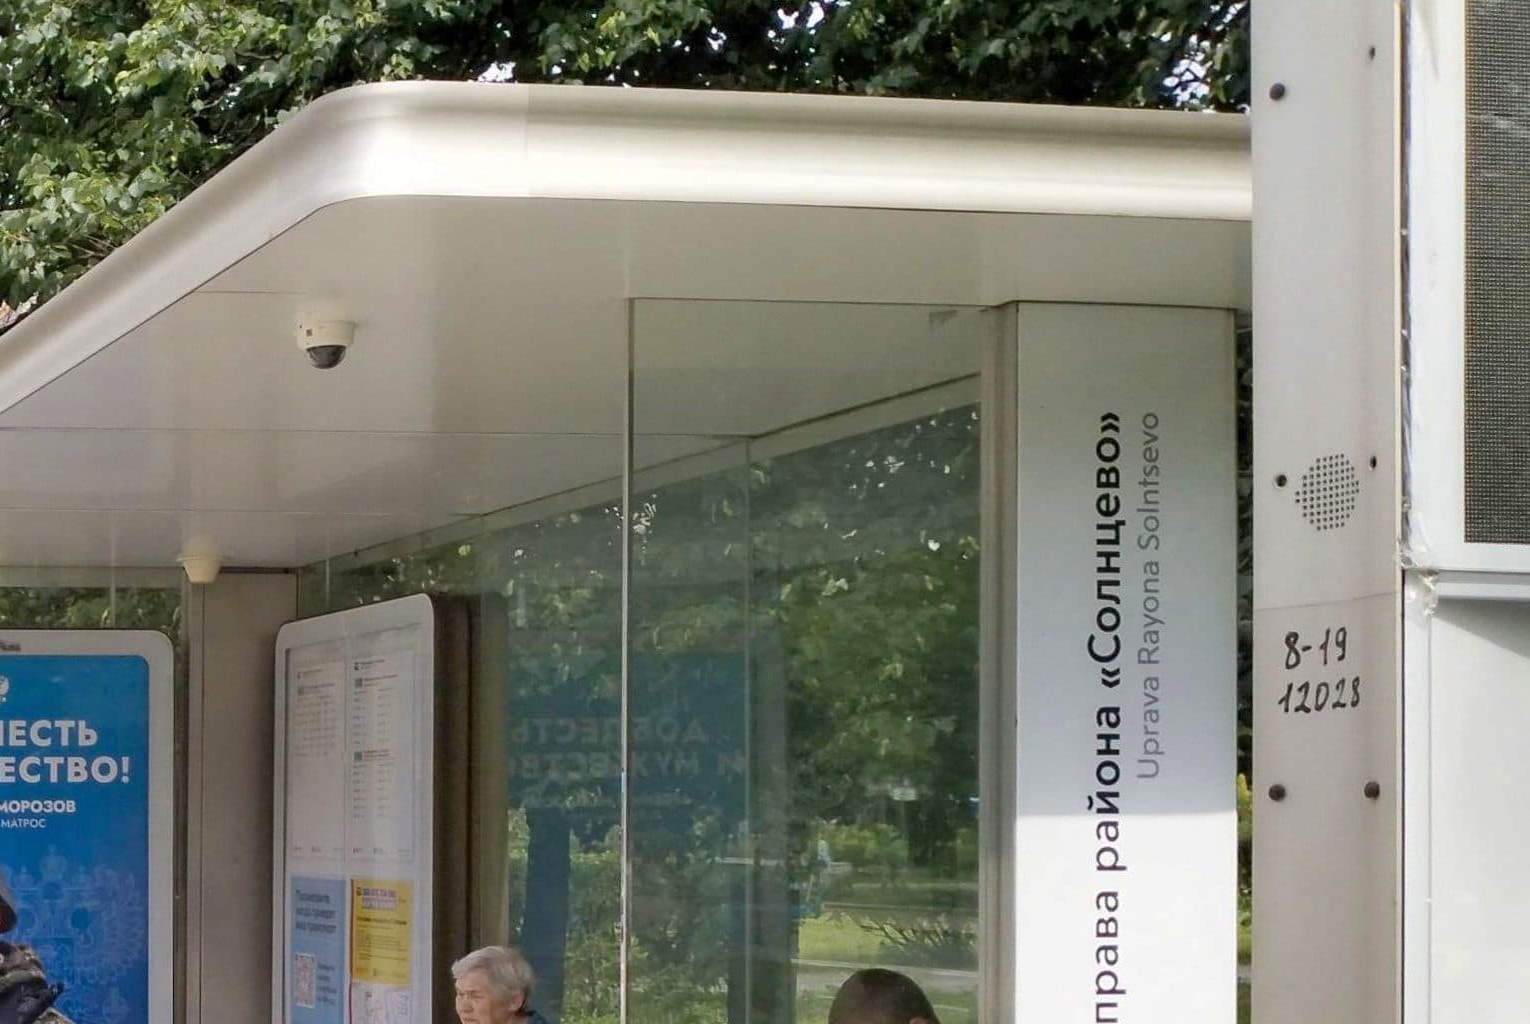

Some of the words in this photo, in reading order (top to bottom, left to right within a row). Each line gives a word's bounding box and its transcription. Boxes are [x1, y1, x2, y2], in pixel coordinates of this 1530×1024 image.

[1136, 412, 1160, 551] Solntsevo
[1087, 412, 1126, 688] «Солнцево»
[1137, 560, 1166, 664] Rayona
[1284, 626, 1347, 669] 8-19
[1137, 676, 1165, 779] Uprava
[1277, 675, 1360, 713] 12028
[1, 818, 47, 829] МАТРОС
[1086, 706, 1127, 872] района
